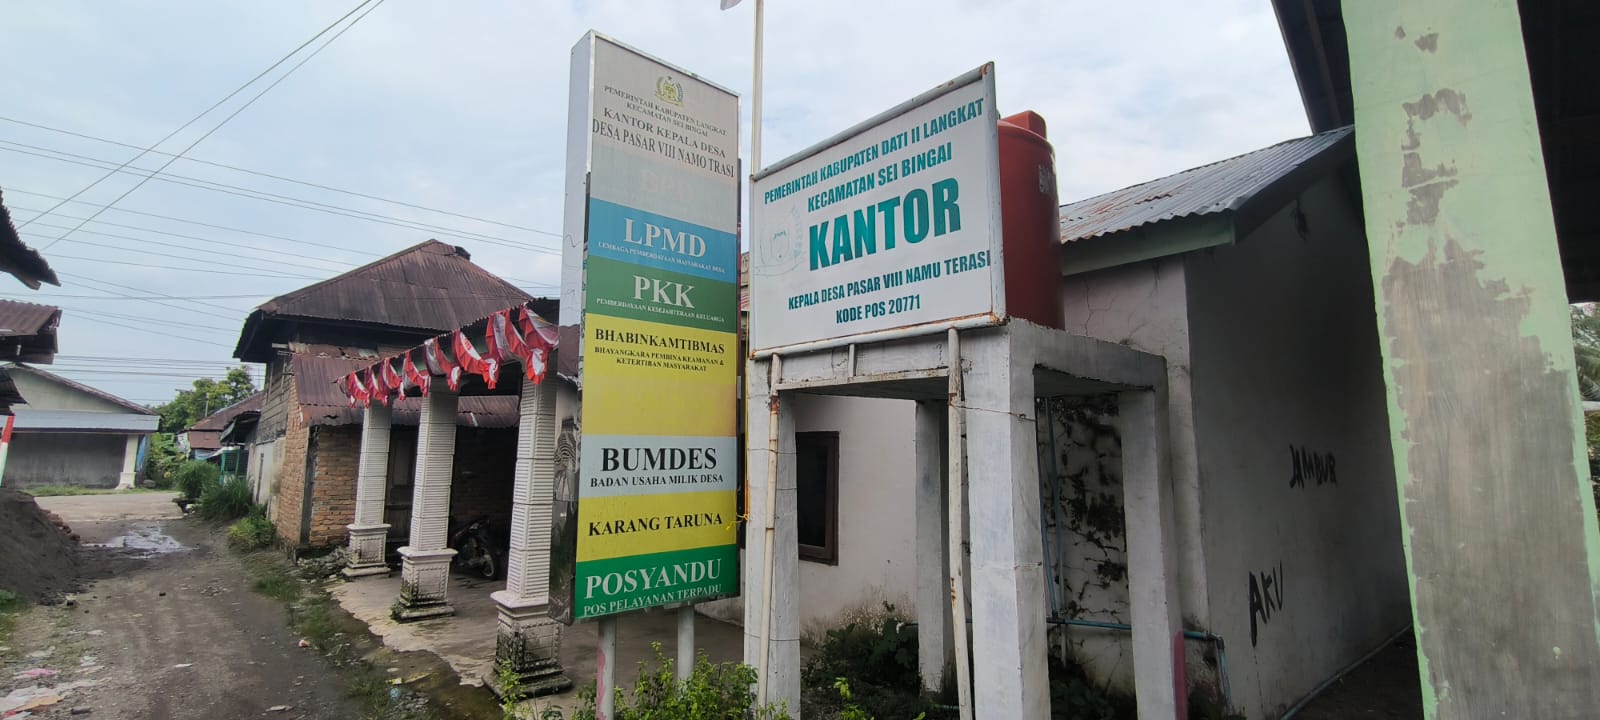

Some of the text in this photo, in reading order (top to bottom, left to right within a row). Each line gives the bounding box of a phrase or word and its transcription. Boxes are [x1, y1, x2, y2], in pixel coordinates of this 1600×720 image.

[604, 85, 727, 136] PEMERINTAH KABUPATEN LANGKAT
[627, 102, 708, 137] KECAMATAN SEI BINGAI
[592, 118, 735, 178] DESA PASAR VIII NAMO TRASI
[604, 107, 726, 158] KANTOR KEPALA DESA
[764, 98, 984, 205] PEMERINTAH KABUPATEN DATI II LANGKAT
[808, 142, 952, 213] KECAMATAN SEI BINGAI
[624, 218, 706, 258] LPMD
[809, 177, 961, 271] KANTOR
[598, 241, 629, 254] LEMBAGA
[633, 275, 695, 309] PKK
[788, 250, 990, 311] KEPALA DESA PASAR VIII NAMU TERASI
[836, 294, 920, 324] KODE POS 20771
[594, 346, 650, 358] BHAYANGKARA
[651, 352, 682, 362] PEMBINA
[682, 356, 718, 365] KEAMANAN
[595, 328, 725, 354] BHABINKAMTIBMAS
[616, 357, 707, 372] KETERTIBAN MASYARAKAT
[601, 447, 717, 472] BUMDES
[590, 473, 723, 487] BADAN USAHA MILIK DESA
[588, 513, 722, 536] KARANG TARUNA
[584, 559, 722, 600] POSYANDU
[583, 584, 722, 617] POS PELAYANAN TERPADU
[1248, 559, 1283, 648] AKU
